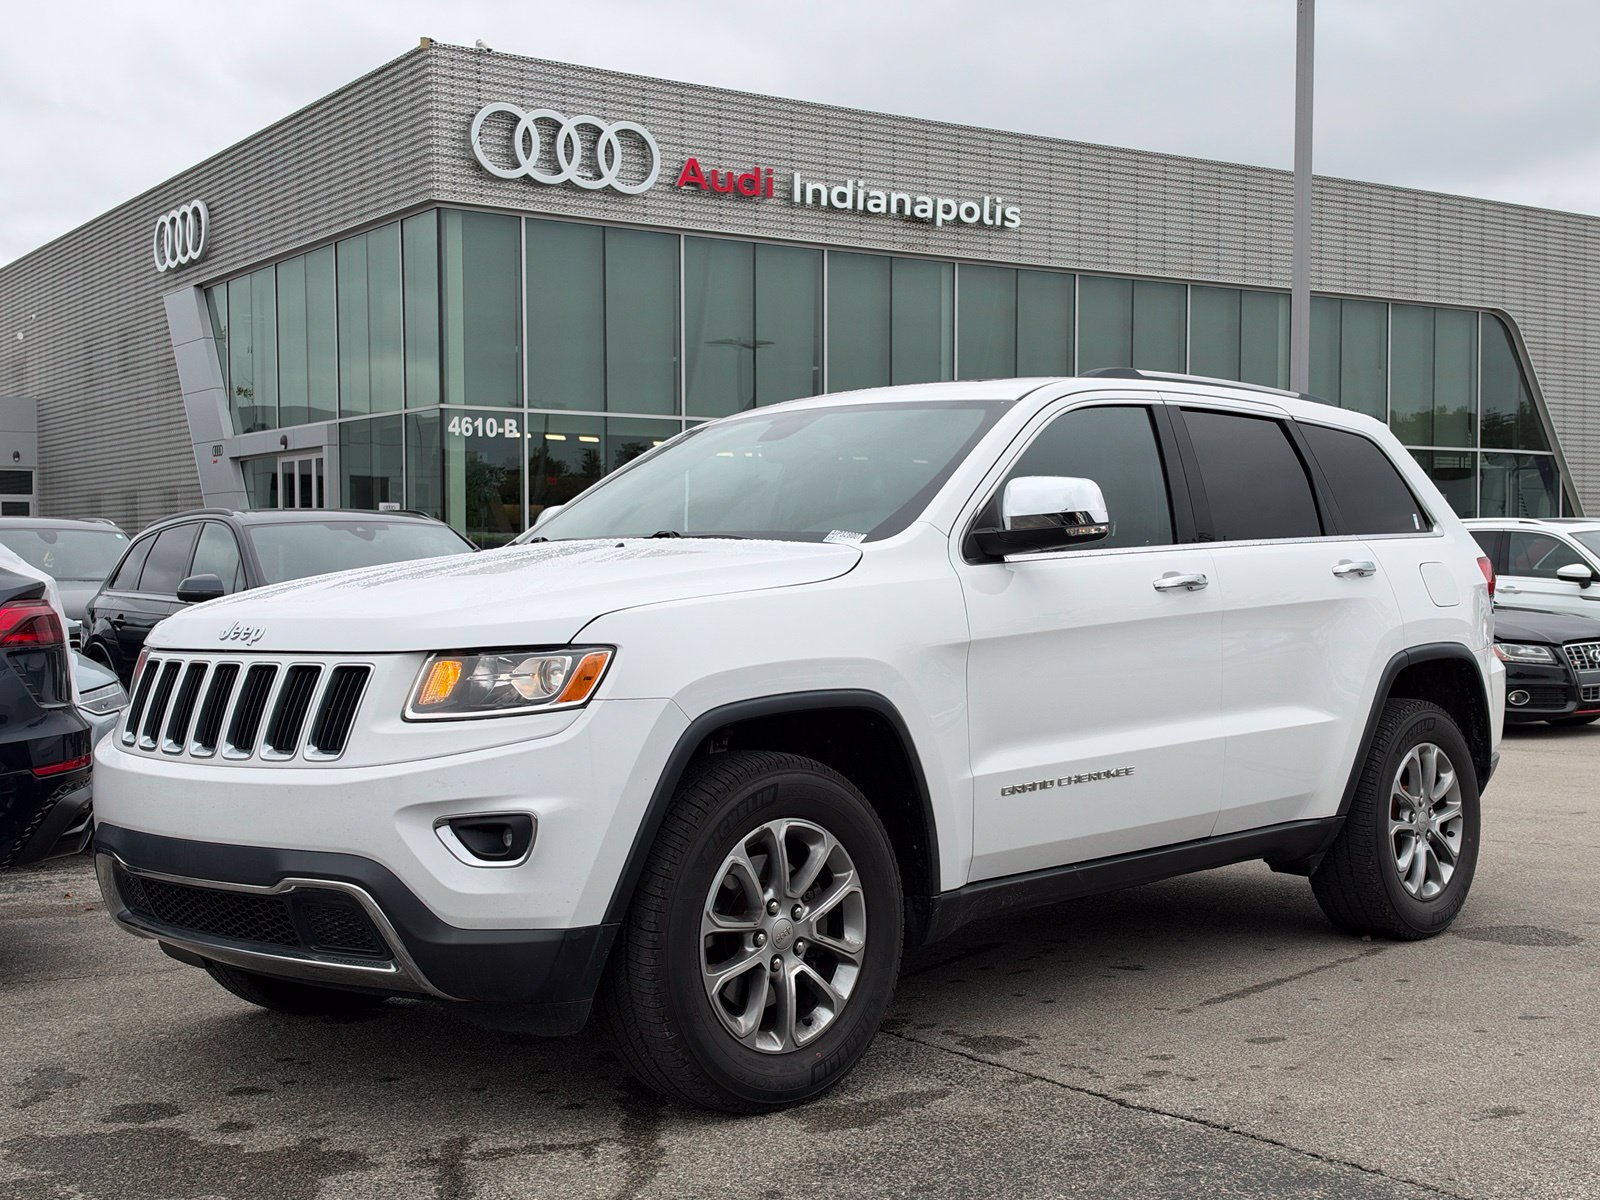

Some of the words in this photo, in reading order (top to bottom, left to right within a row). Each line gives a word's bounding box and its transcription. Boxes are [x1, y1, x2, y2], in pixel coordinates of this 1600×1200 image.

[676, 157, 774, 199] Audi
[792, 172, 1021, 228] Indianapolis
[448, 416, 518, 438] 4610-B
[219, 619, 267, 647] Jeep
[1001, 779, 1054, 797] GRAND
[1057, 765, 1136, 787] CHEROKEE
